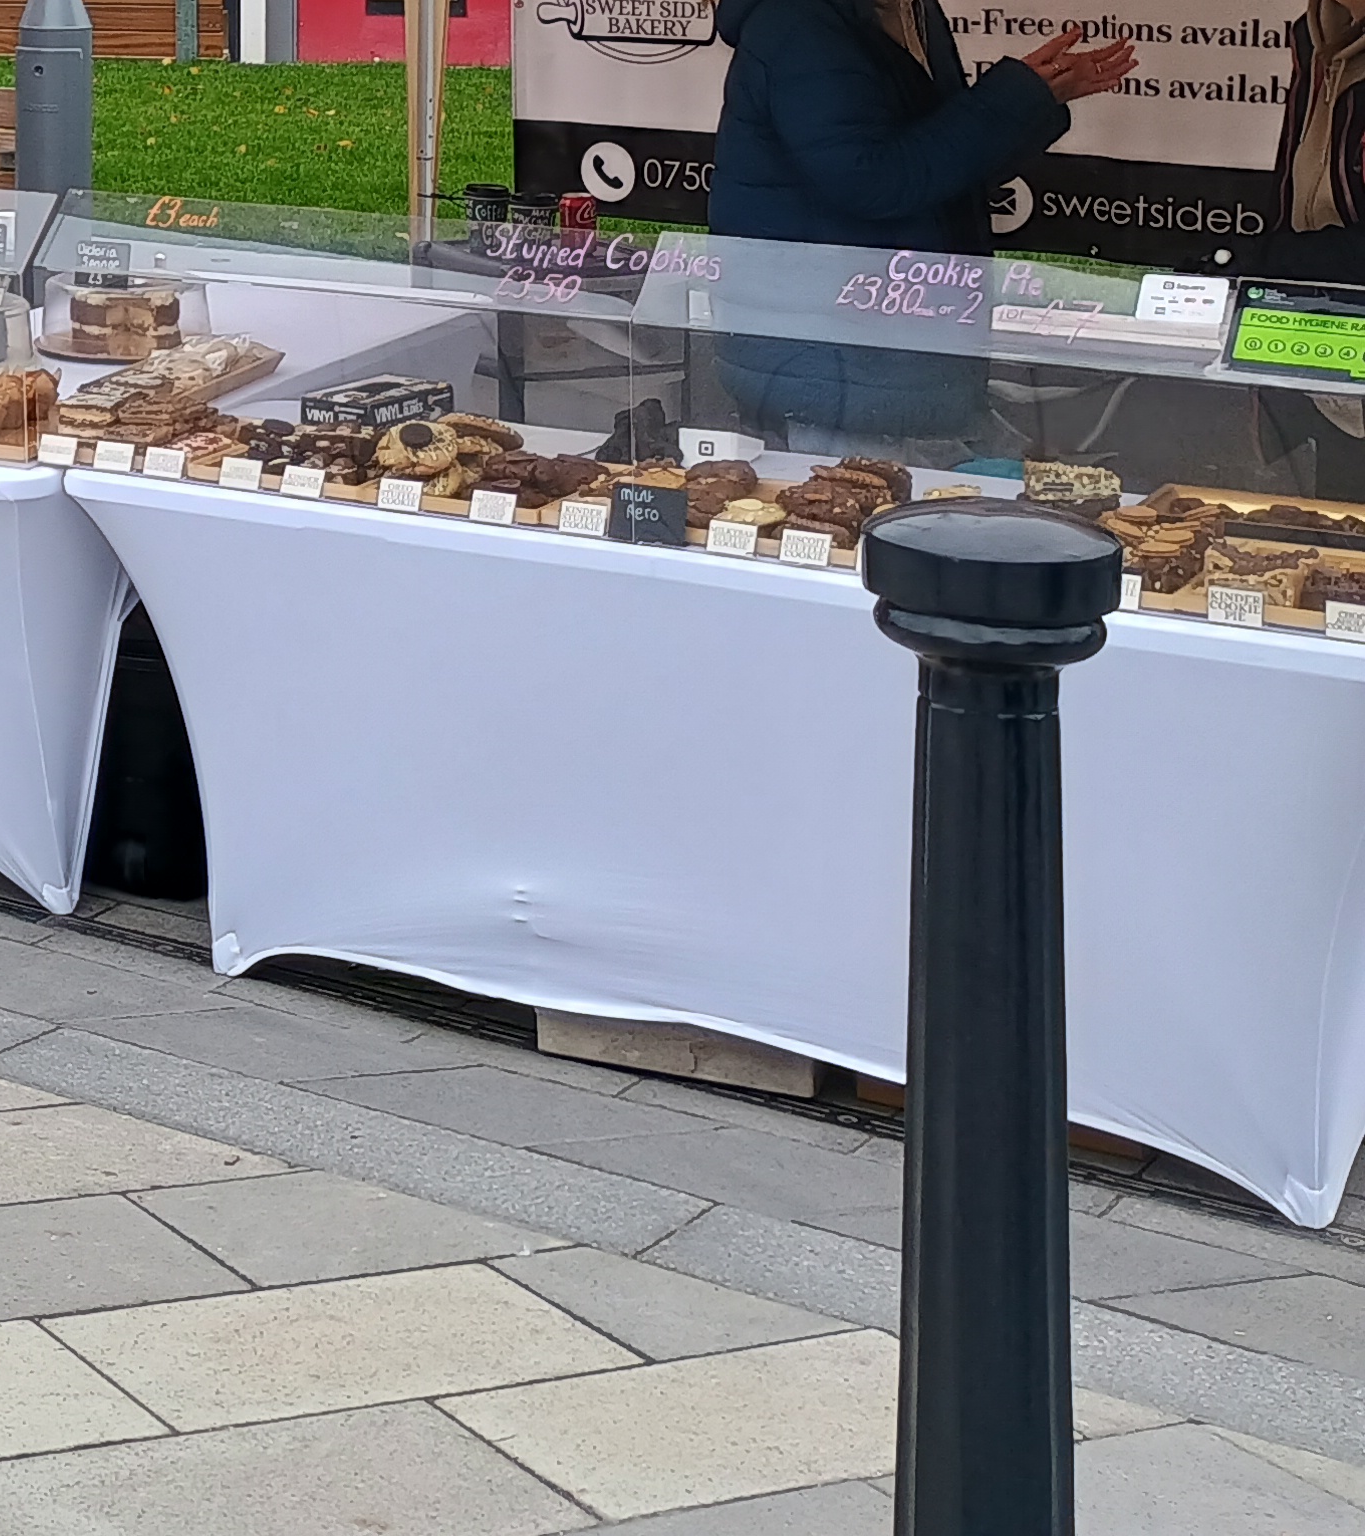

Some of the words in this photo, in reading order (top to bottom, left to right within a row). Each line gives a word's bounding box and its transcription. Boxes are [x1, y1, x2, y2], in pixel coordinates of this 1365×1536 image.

[659, 1, 708, 20] SIDE
[607, 18, 691, 37] BAKERY
[1061, 14, 1172, 44] options
[145, 195, 183, 228] £3
[179, 206, 219, 228] each
[1041, 190, 1264, 235] sweetsideb
[606, 233, 721, 281] Cookies
[888, 250, 984, 289] Cookie
[1001, 261, 1044, 296] Pie
[956, 291, 983, 325] 2
[1250, 313, 1290, 325] FOOD
[1292, 317, 1348, 331] HYGIENE
[374, 402, 403, 423] VINYL
[387, 483, 413, 492] OREO
[381, 498, 416, 507] COOKIE
[564, 505, 603, 516] KINDER
[563, 520, 601, 532] COOKIE
[713, 540, 747, 550] COOKIE
[784, 550, 824, 561] COOKIE
[1209, 599, 1261, 614] COOKIE
[1210, 590, 1260, 605] KINDER
[1224, 611, 1246, 622] PIE
